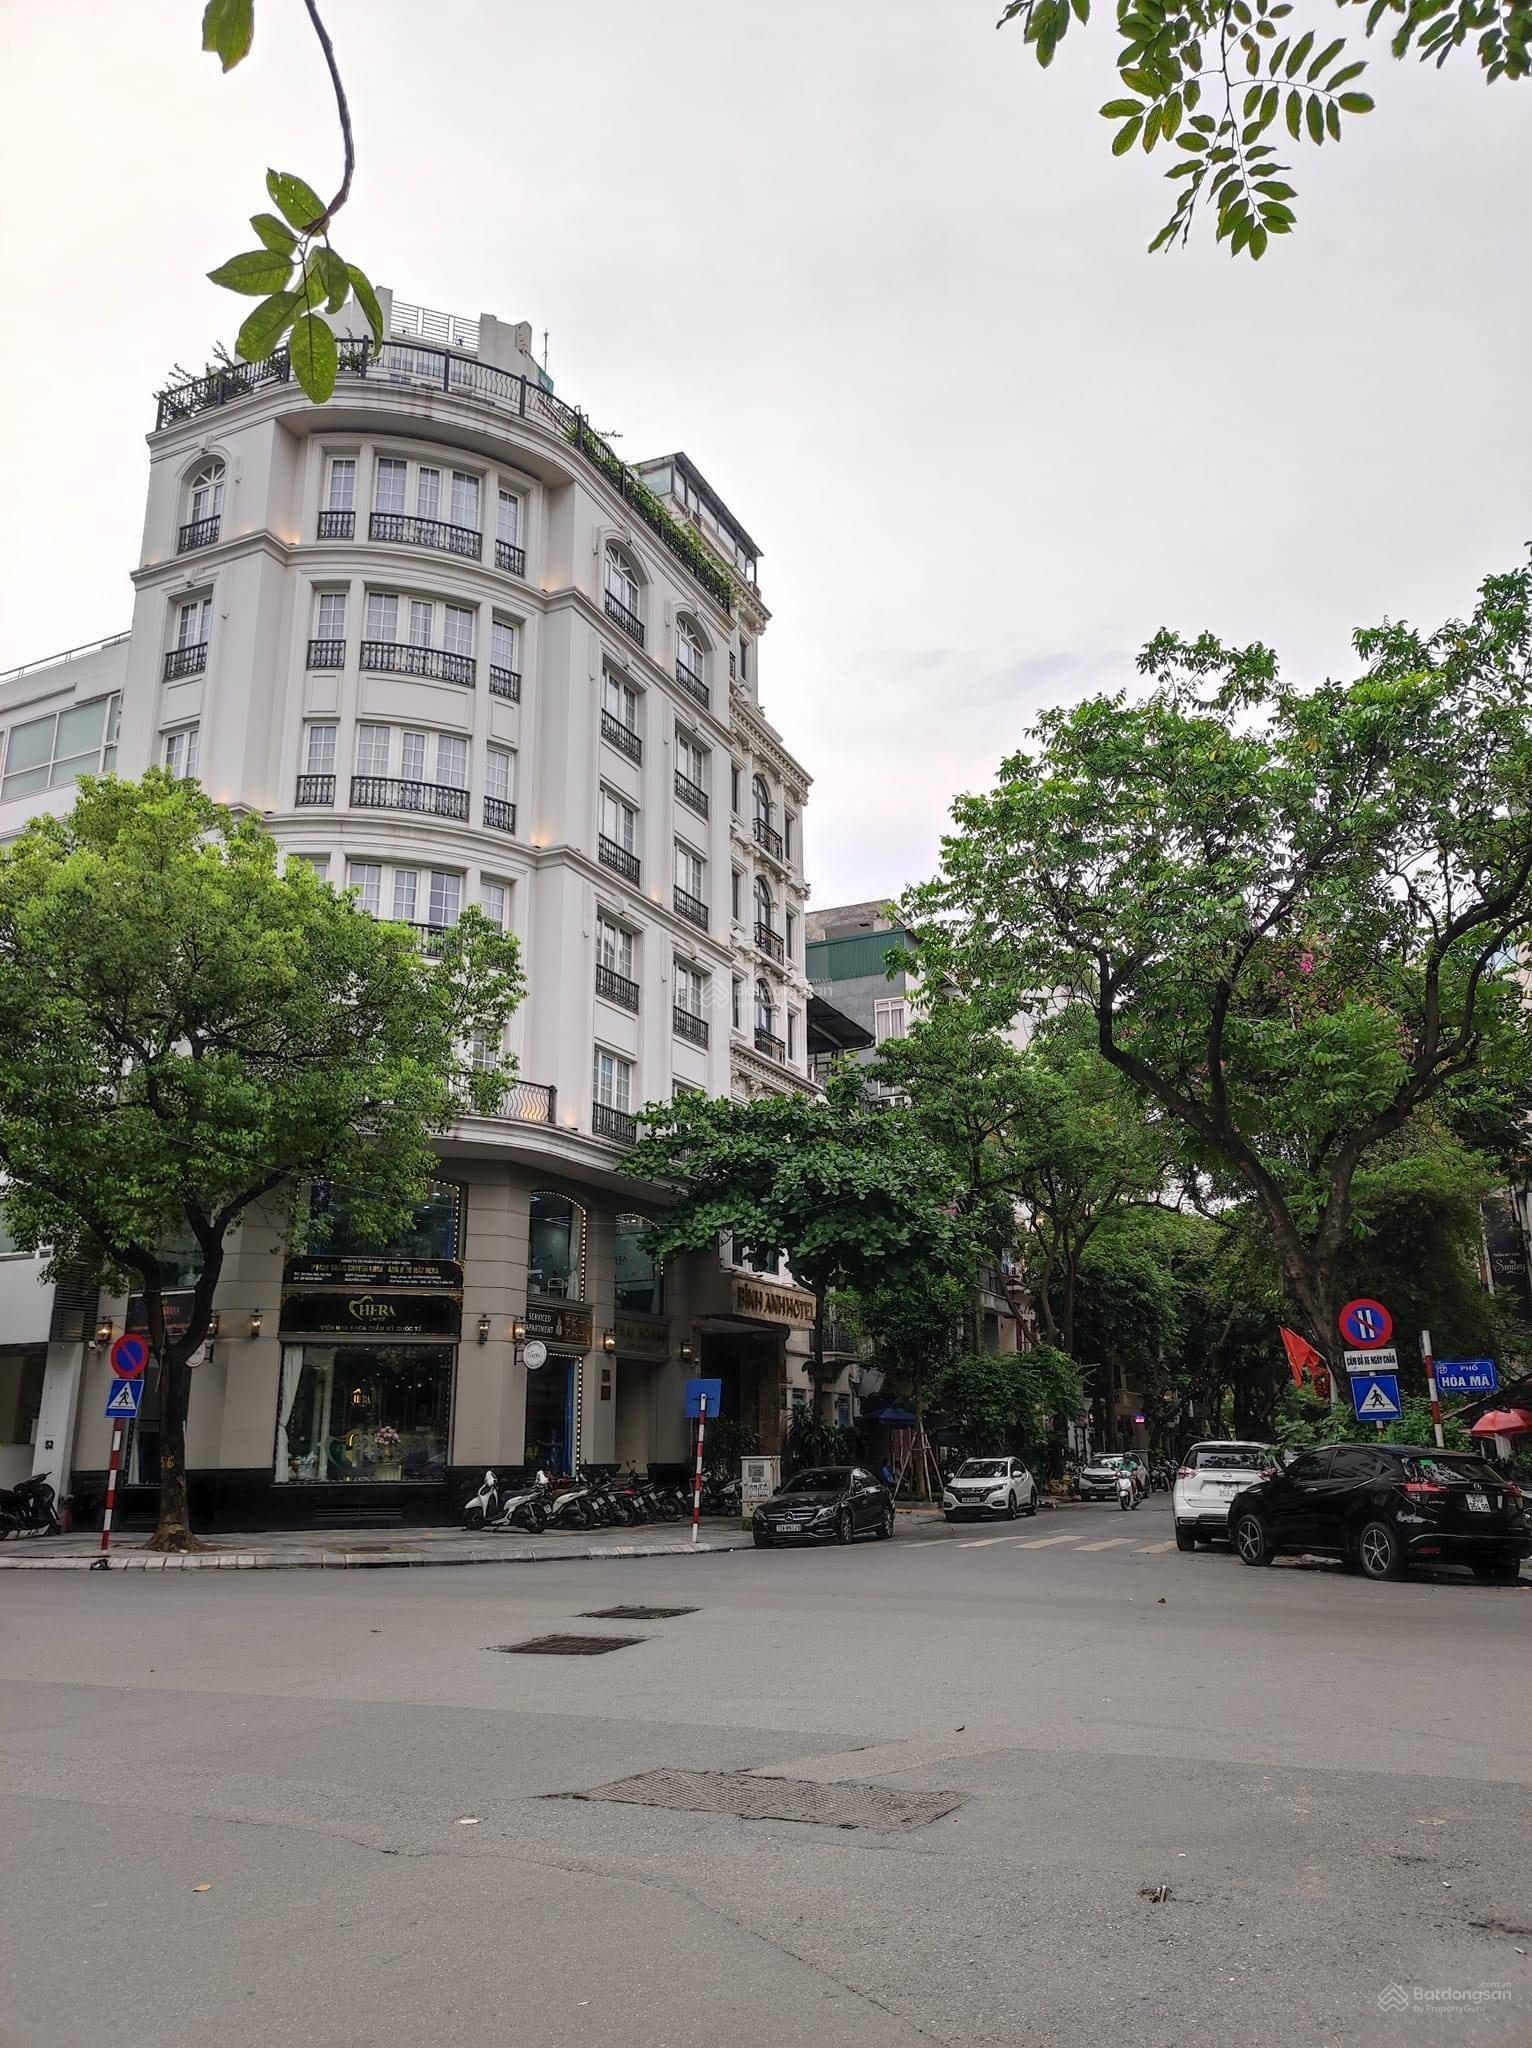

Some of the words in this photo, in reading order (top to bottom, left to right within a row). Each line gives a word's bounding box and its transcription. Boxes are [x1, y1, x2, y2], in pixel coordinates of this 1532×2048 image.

[1494, 1258, 1526, 1275] Smiley
[528, 1312, 552, 1323] SERVICED
[1441, 1374, 1467, 1387] HÒA
[1469, 1373, 1490, 1387] MÃ
